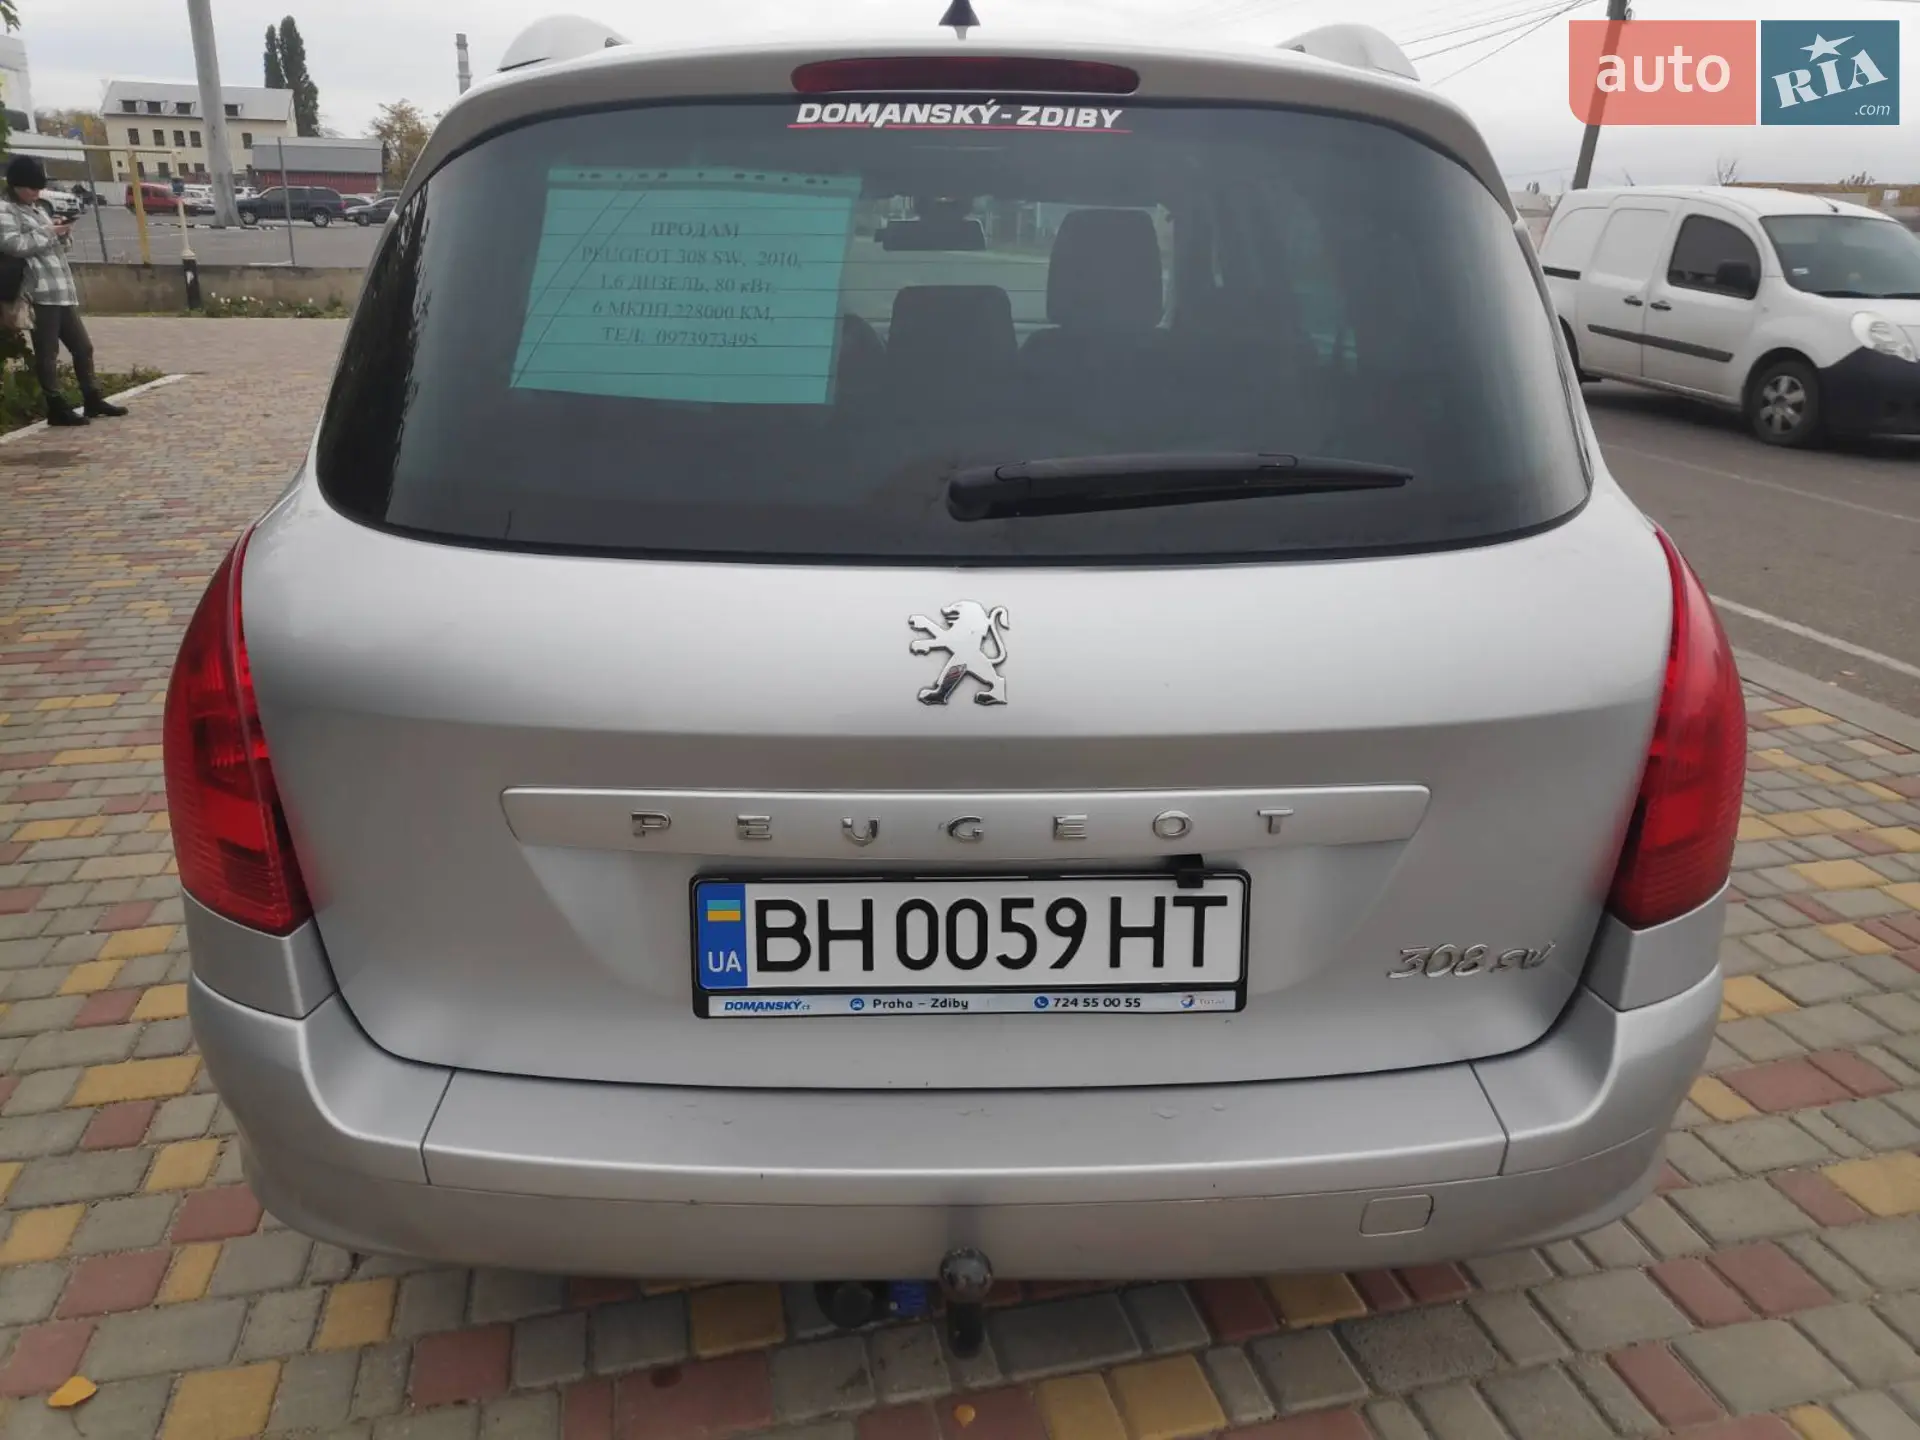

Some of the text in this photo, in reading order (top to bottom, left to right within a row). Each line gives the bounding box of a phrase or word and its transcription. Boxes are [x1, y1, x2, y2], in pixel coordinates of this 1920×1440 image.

[650, 221, 740, 238] ПРОДАМ
[581, 246, 671, 264] PEUGEOT
[678, 248, 707, 265] 308
[715, 277, 735, 292] 80
[592, 300, 603, 315] 6
[631, 806, 1295, 848] PEUGEOT
[708, 894, 1229, 974] UA BH 0059 HT
[1387, 943, 1489, 979] 308
[873, 998, 914, 1009] Praha
[930, 998, 969, 1011] Zdiby
[1053, 997, 1079, 1008] 724
[1083, 997, 1100, 1008] 55
[1103, 997, 1121, 1008] 00
[1124, 997, 1141, 1008] 55
